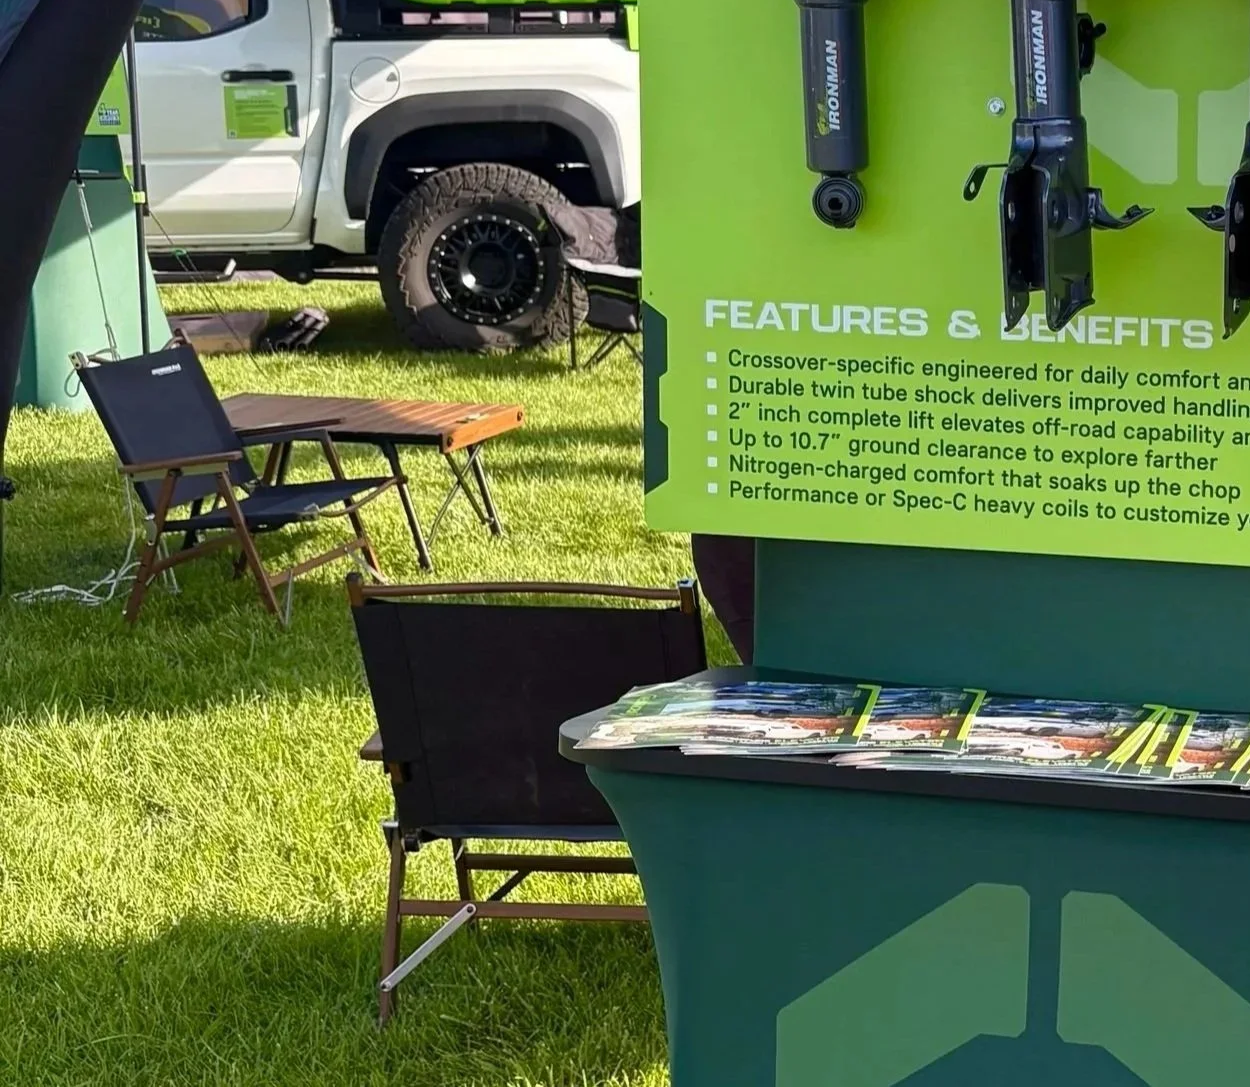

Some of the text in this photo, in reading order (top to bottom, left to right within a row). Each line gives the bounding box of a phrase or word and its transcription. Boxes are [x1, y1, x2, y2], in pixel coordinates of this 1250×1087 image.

[1031, 10, 1047, 105] IRONMAN
[825, 40, 840, 130] IRONMAN
[705, 299, 929, 337] FEATURES
[947, 309, 981, 339] &
[728, 348, 915, 377] Crossover-specific
[921, 359, 1038, 383] engineered
[1044, 362, 1075, 383] for
[1080, 364, 1129, 390] daily
[1136, 369, 1221, 390] comfort
[729, 375, 805, 397] Durable
[810, 380, 855, 399] twin
[861, 382, 908, 402] tube
[914, 384, 975, 405] shock
[981, 387, 1062, 409] delivers
[1069, 390, 1166, 416] improved
[758, 402, 801, 423] inch
[807, 408, 902, 431] complete
[908, 410, 935, 430] lift
[941, 412, 1025, 435] elevates
[1032, 417, 1116, 439] off-road
[1123, 423, 1225, 449] capability
[729, 427, 757, 452] Up
[762, 431, 783, 449] to
[848, 437, 920, 457] ground
[927, 438, 1027, 461] clearance
[1033, 444, 1054, 463] to
[1061, 447, 1138, 470] explore
[1144, 449, 1219, 471] farther
[729, 454, 1241, 504] Nitrogen-charged comfort that soaks up the chop
[730, 480, 859, 505] Performance
[865, 492, 887, 506] or
[892, 489, 967, 513] Spec-C
[974, 493, 1036, 519] heavy
[1042, 498, 1089, 518] coils
[1095, 502, 1117, 520] to
[1123, 505, 1230, 526] customize
